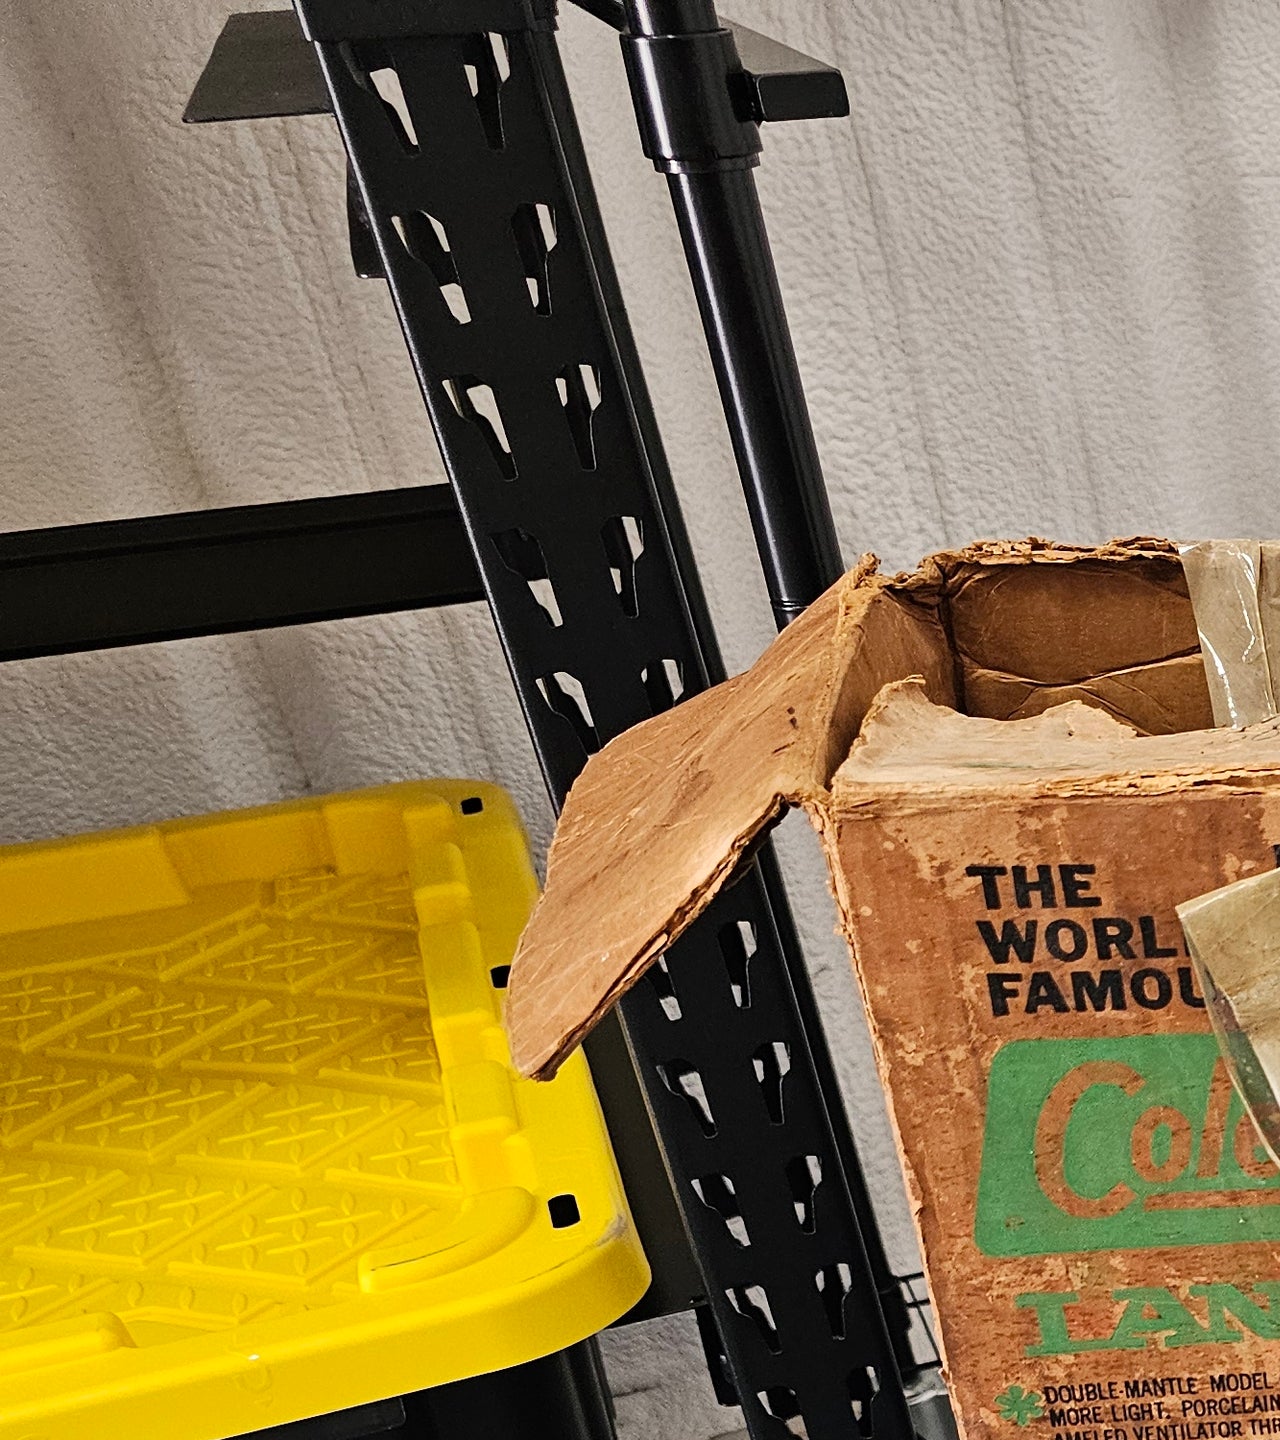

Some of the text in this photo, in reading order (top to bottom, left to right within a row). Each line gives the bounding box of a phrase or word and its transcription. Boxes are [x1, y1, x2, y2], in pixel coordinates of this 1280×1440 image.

[965, 864, 1102, 910] THE
[975, 915, 1190, 964] WORL
[986, 967, 1206, 1017] FAMOU
[1044, 1377, 1199, 1404] DOUBLE-MANTLE
[1210, 1373, 1274, 1391] MODEL
[1049, 1405, 1103, 1427] MORE
[1112, 1402, 1170, 1422] LIGHT.
[1181, 1397, 1280, 1417] PORCELAIN
